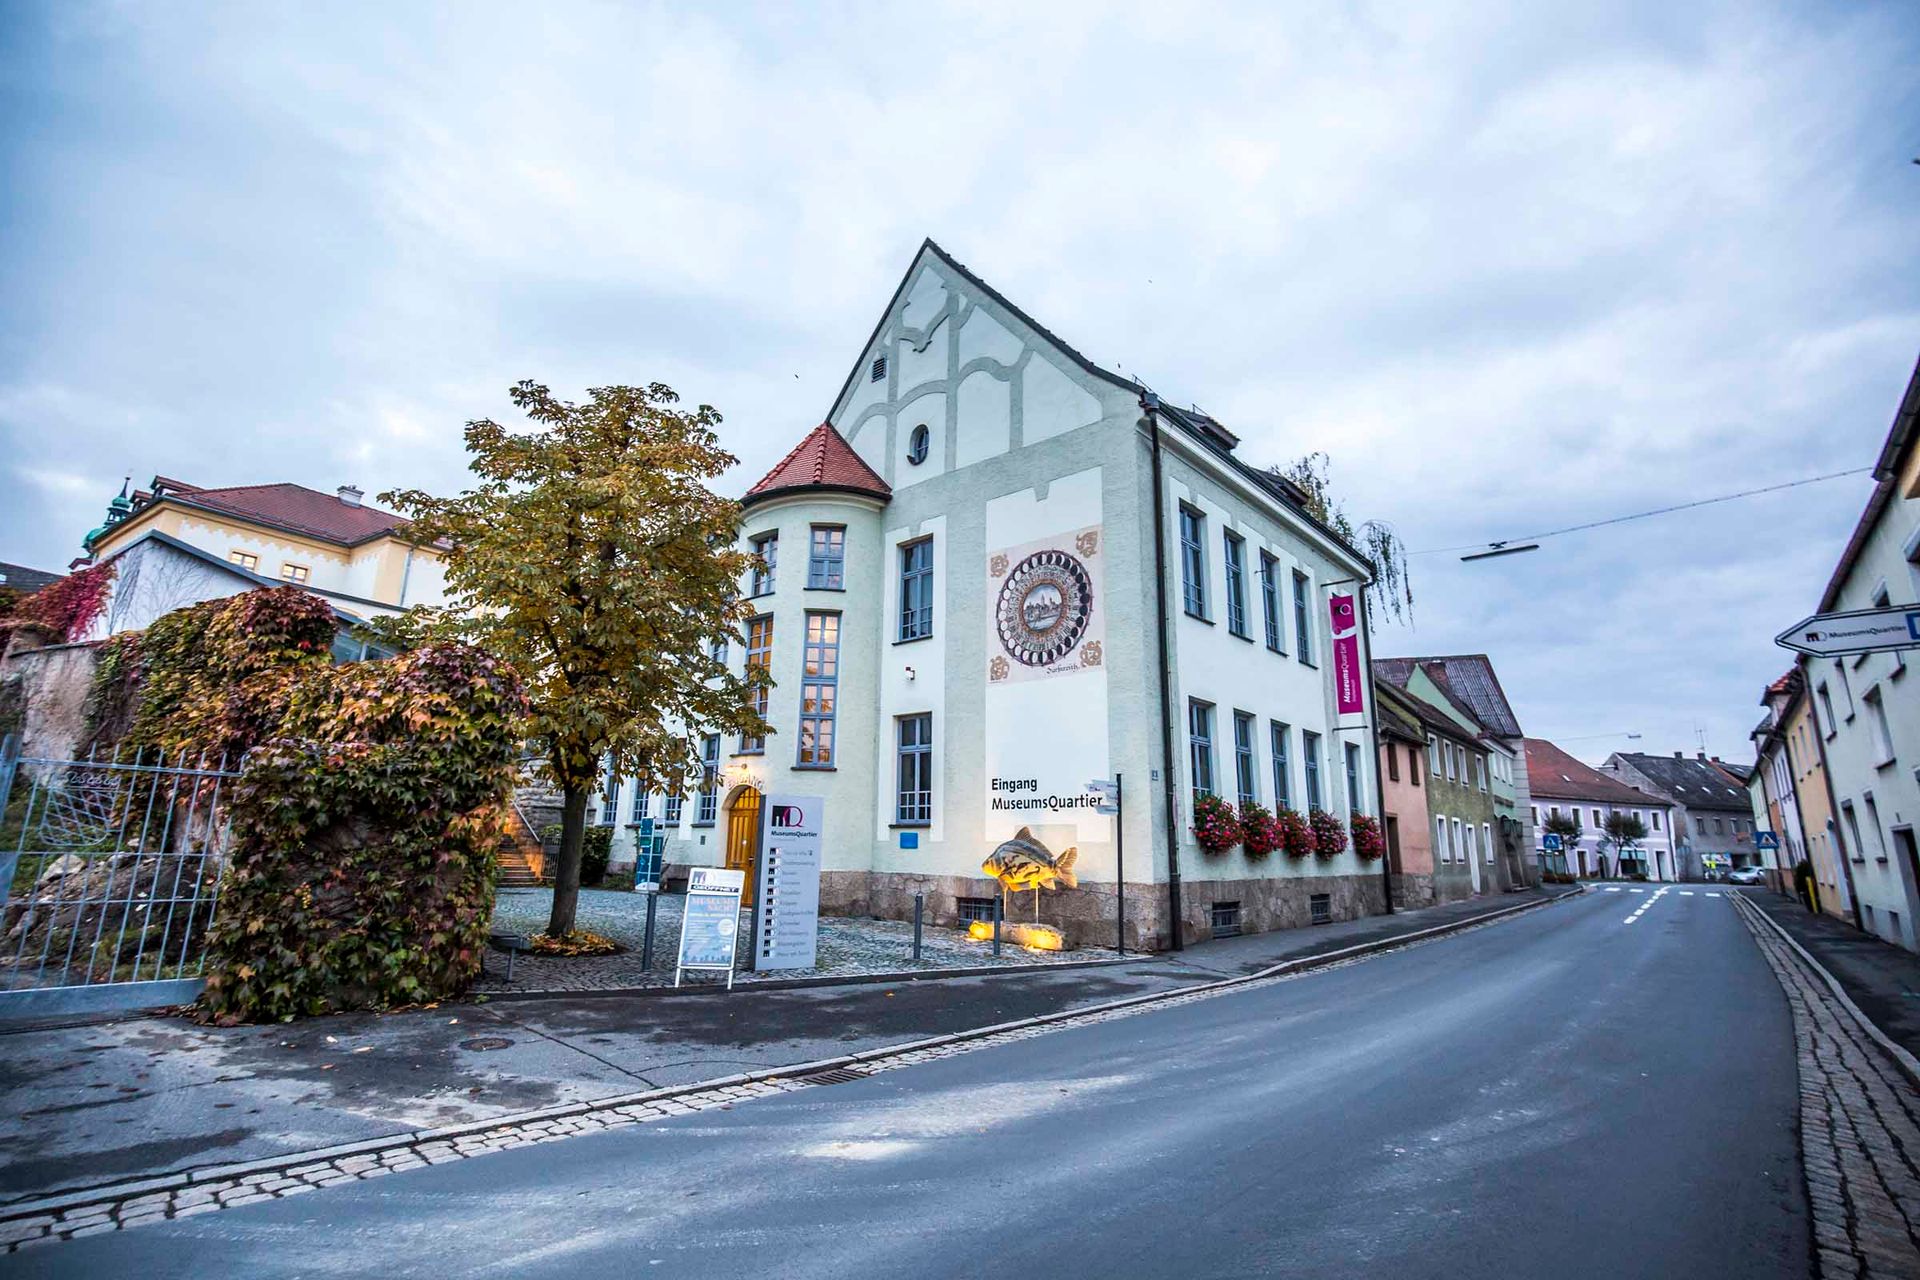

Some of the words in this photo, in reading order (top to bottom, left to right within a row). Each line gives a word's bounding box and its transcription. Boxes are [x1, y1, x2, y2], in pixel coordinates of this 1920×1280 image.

[1828, 625, 1907, 639] MuseumsQuartier
[1339, 642, 1352, 704] MuseumsQuartier
[991, 778, 1038, 793] Eingang
[991, 793, 1104, 812] MuseumsQuartier
[770, 830, 818, 838] MuseumsQuartier
